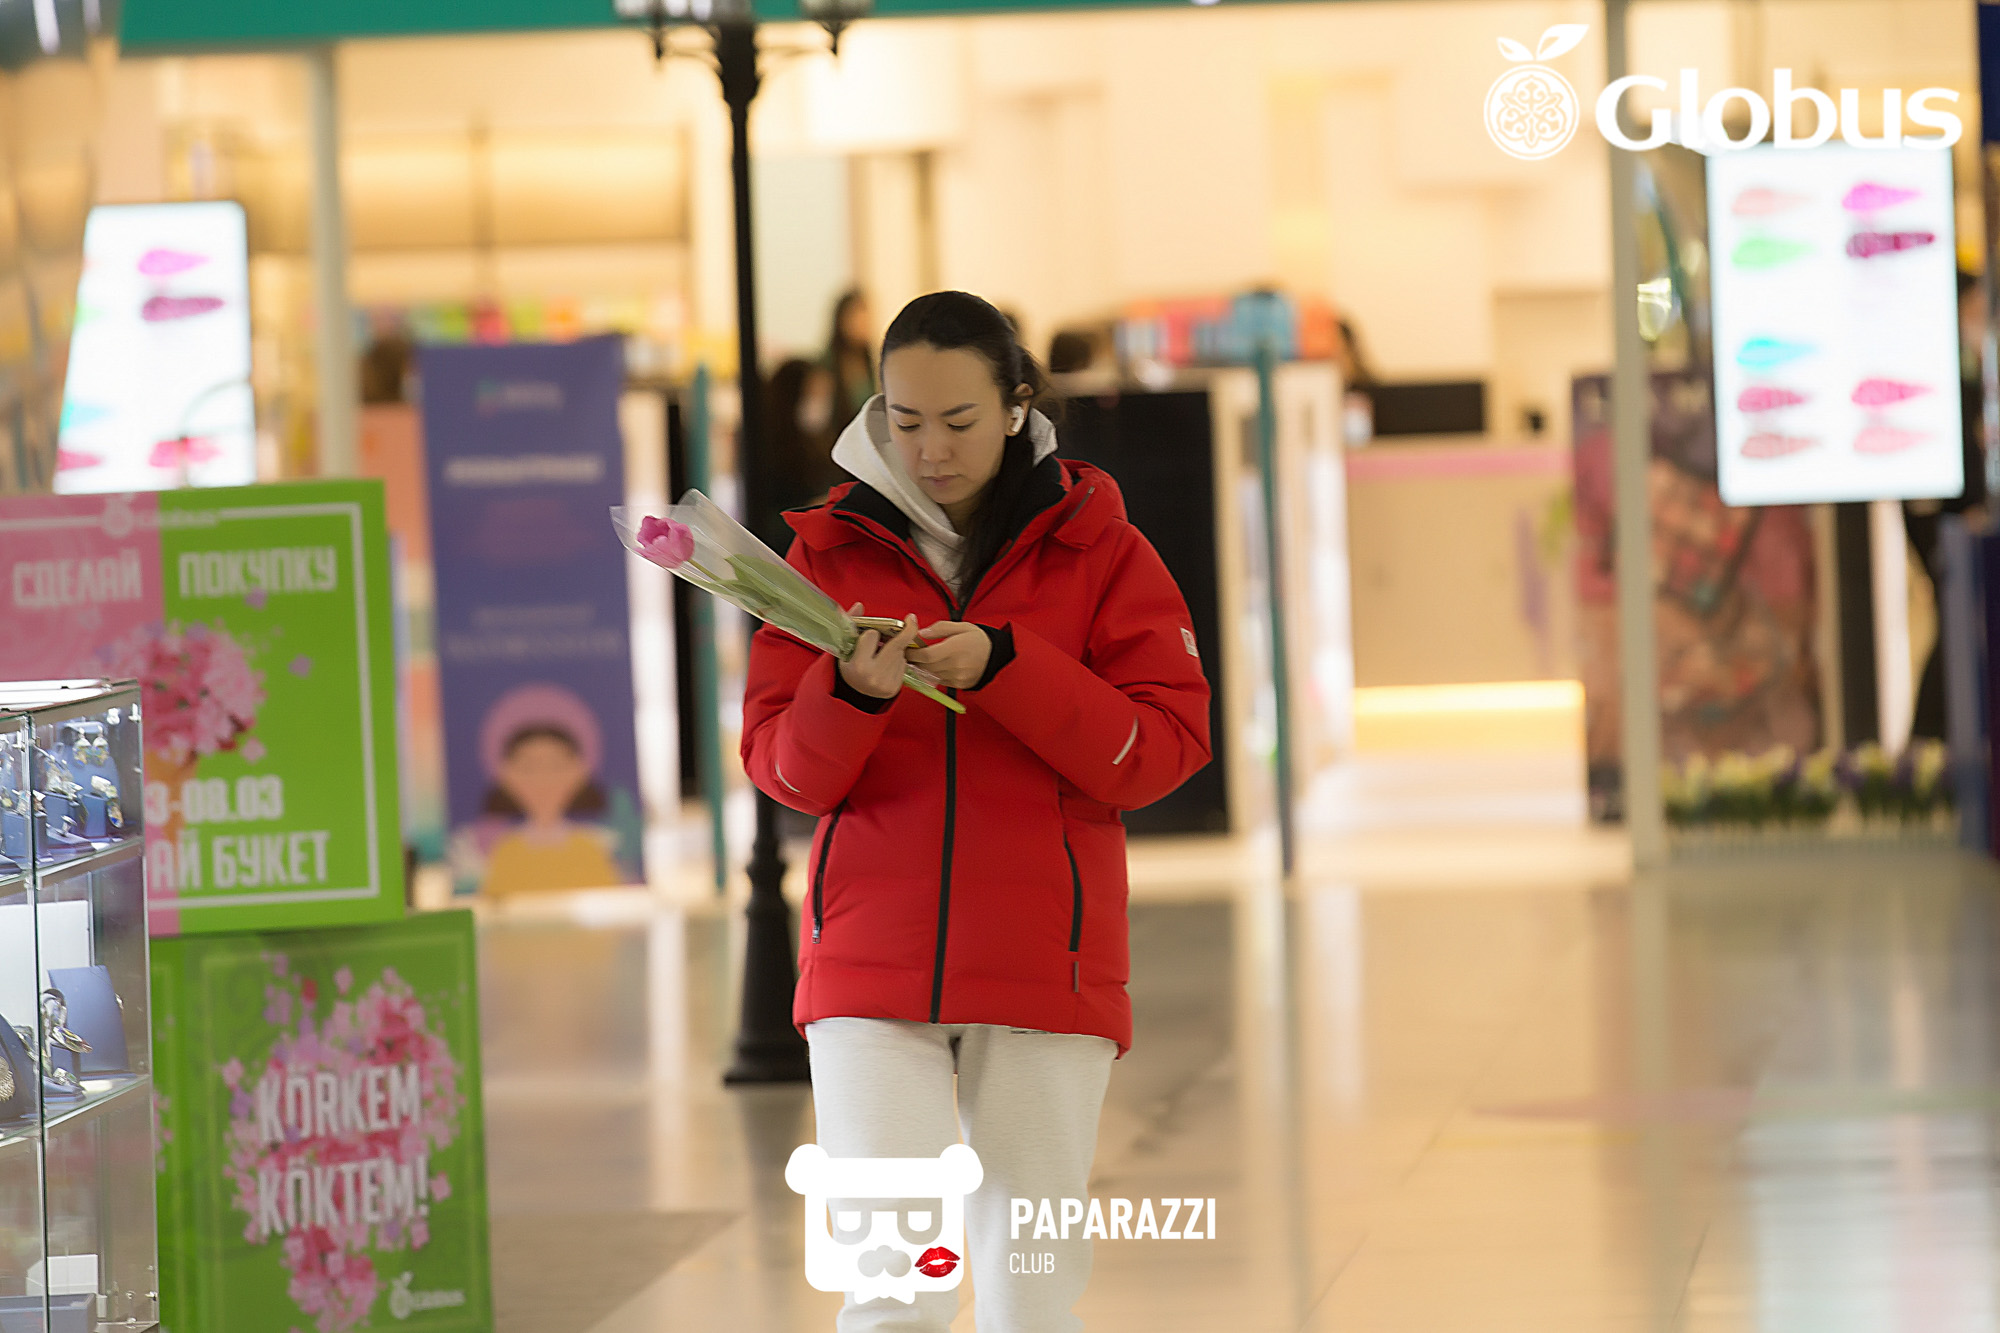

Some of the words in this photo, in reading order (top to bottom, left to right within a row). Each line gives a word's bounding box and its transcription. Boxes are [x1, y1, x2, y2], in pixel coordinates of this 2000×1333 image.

[13, 548, 142, 608] СДЕЛАЙ
[179, 546, 337, 598] ПОКУПКУ
[212, 829, 330, 889] БУКЕТ
[258, 1062, 421, 1142] KÖRKEM
[259, 1151, 430, 1236] KÖKTEM!
